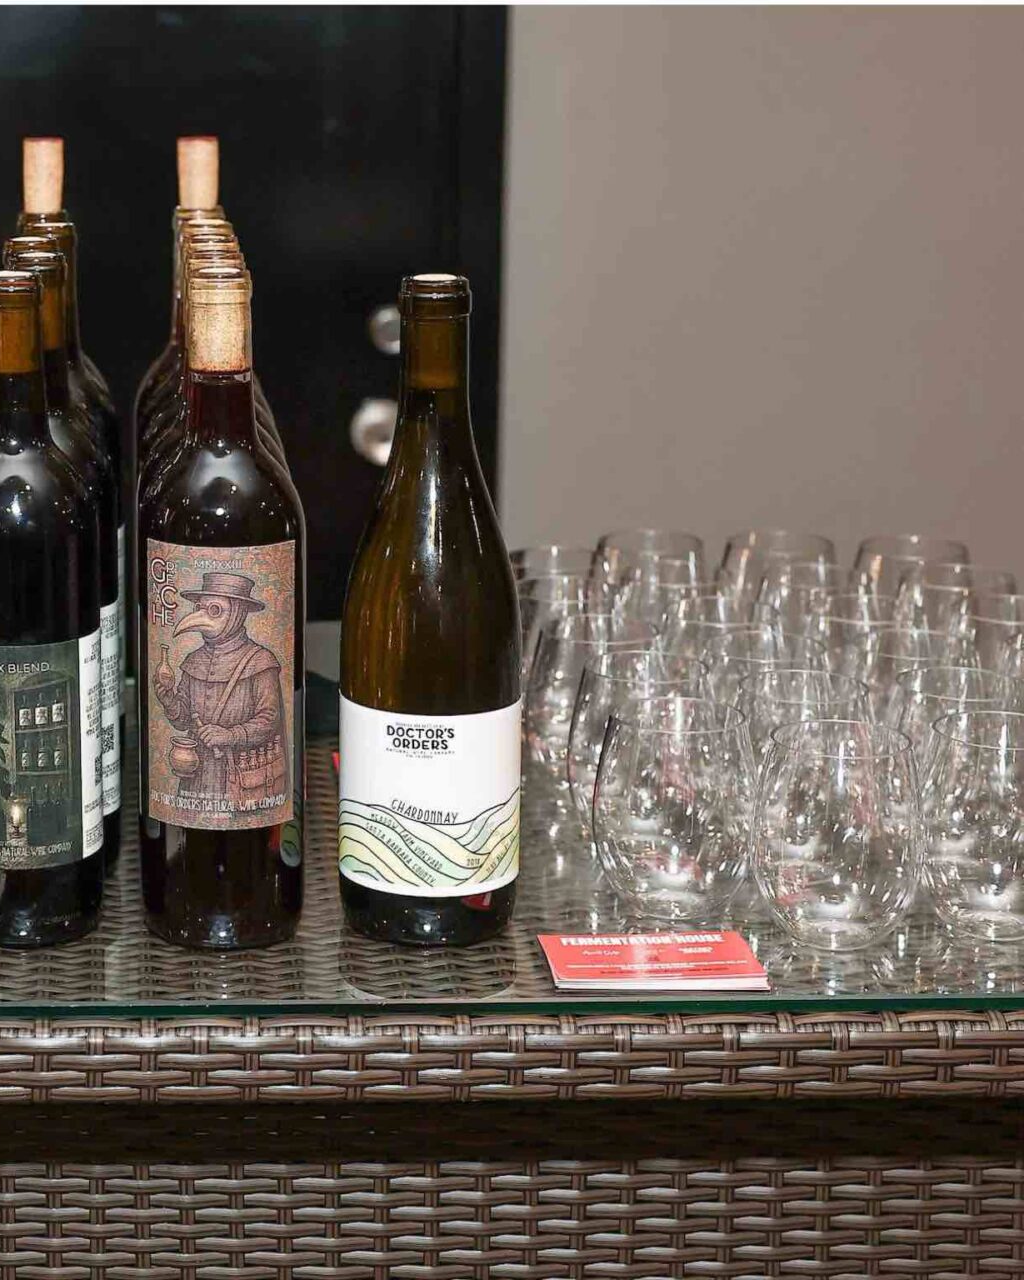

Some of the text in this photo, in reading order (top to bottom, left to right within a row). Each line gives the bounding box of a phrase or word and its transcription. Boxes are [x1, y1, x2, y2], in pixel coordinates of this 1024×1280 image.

[8, 662, 50, 674] BLEND
[387, 725, 454, 739] DOCTOR'S
[393, 737, 448, 750] ORDERS
[391, 799, 459, 824] CHARDONNAY
